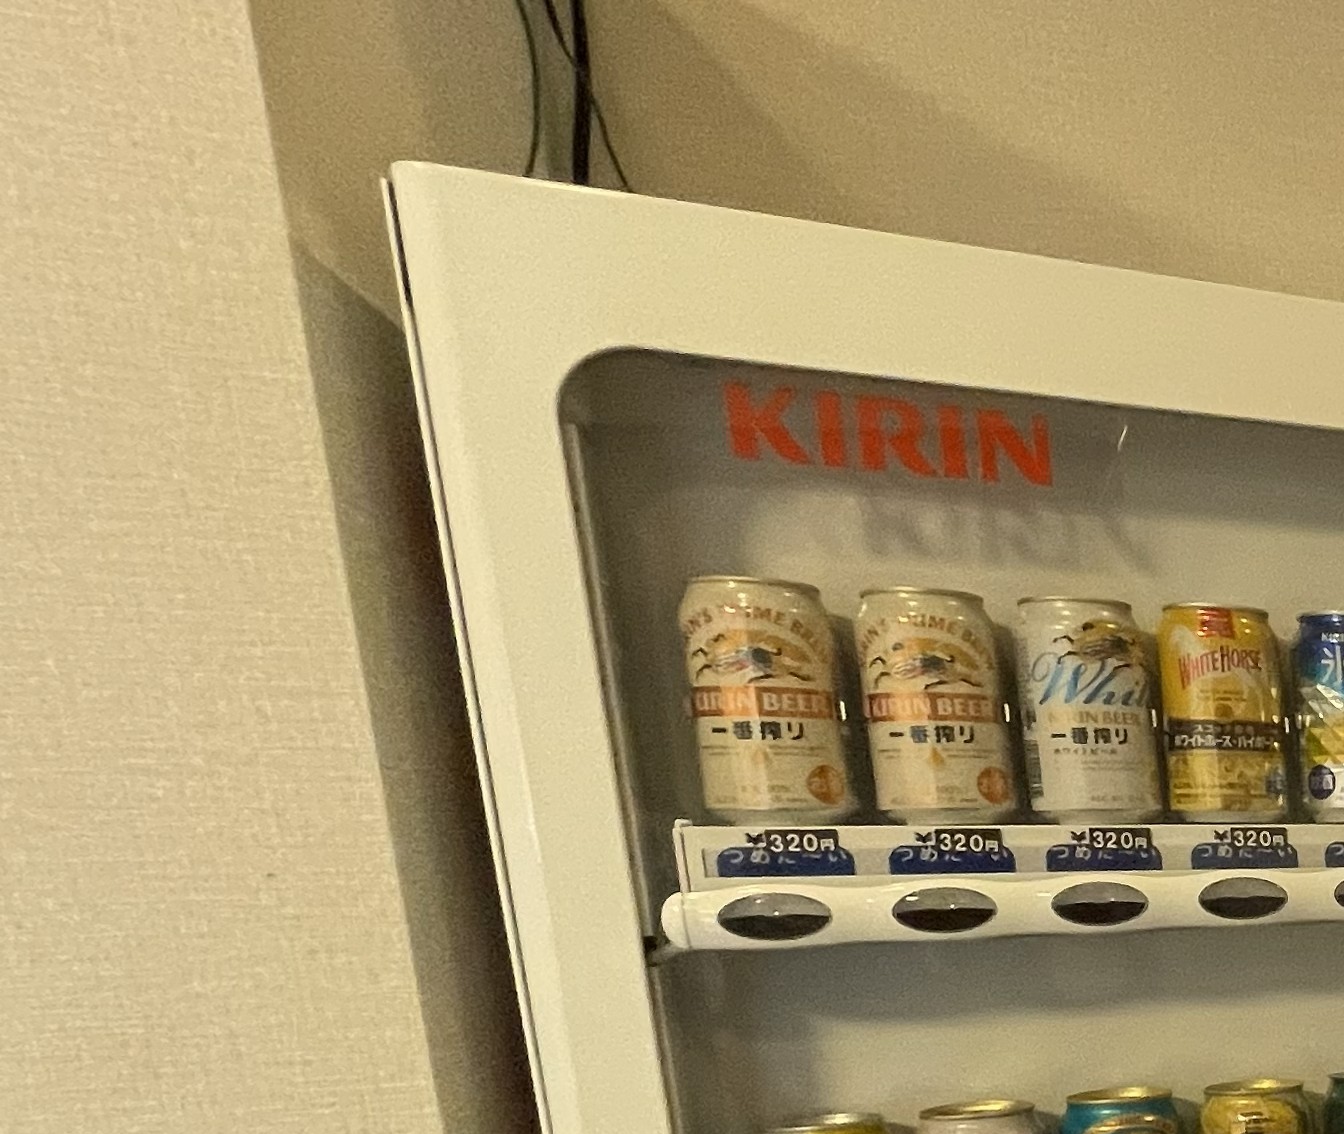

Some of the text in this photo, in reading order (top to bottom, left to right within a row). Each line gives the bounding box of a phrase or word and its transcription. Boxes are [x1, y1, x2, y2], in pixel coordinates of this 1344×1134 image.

[723, 380, 1053, 488] KIRIN
[1179, 651, 1219, 690] WHITE
[937, 695, 996, 719] BEER
[712, 719, 804, 741] 一番搾り
[889, 723, 975, 744] 一番搾り
[1051, 727, 1128, 745] 一番搾り
